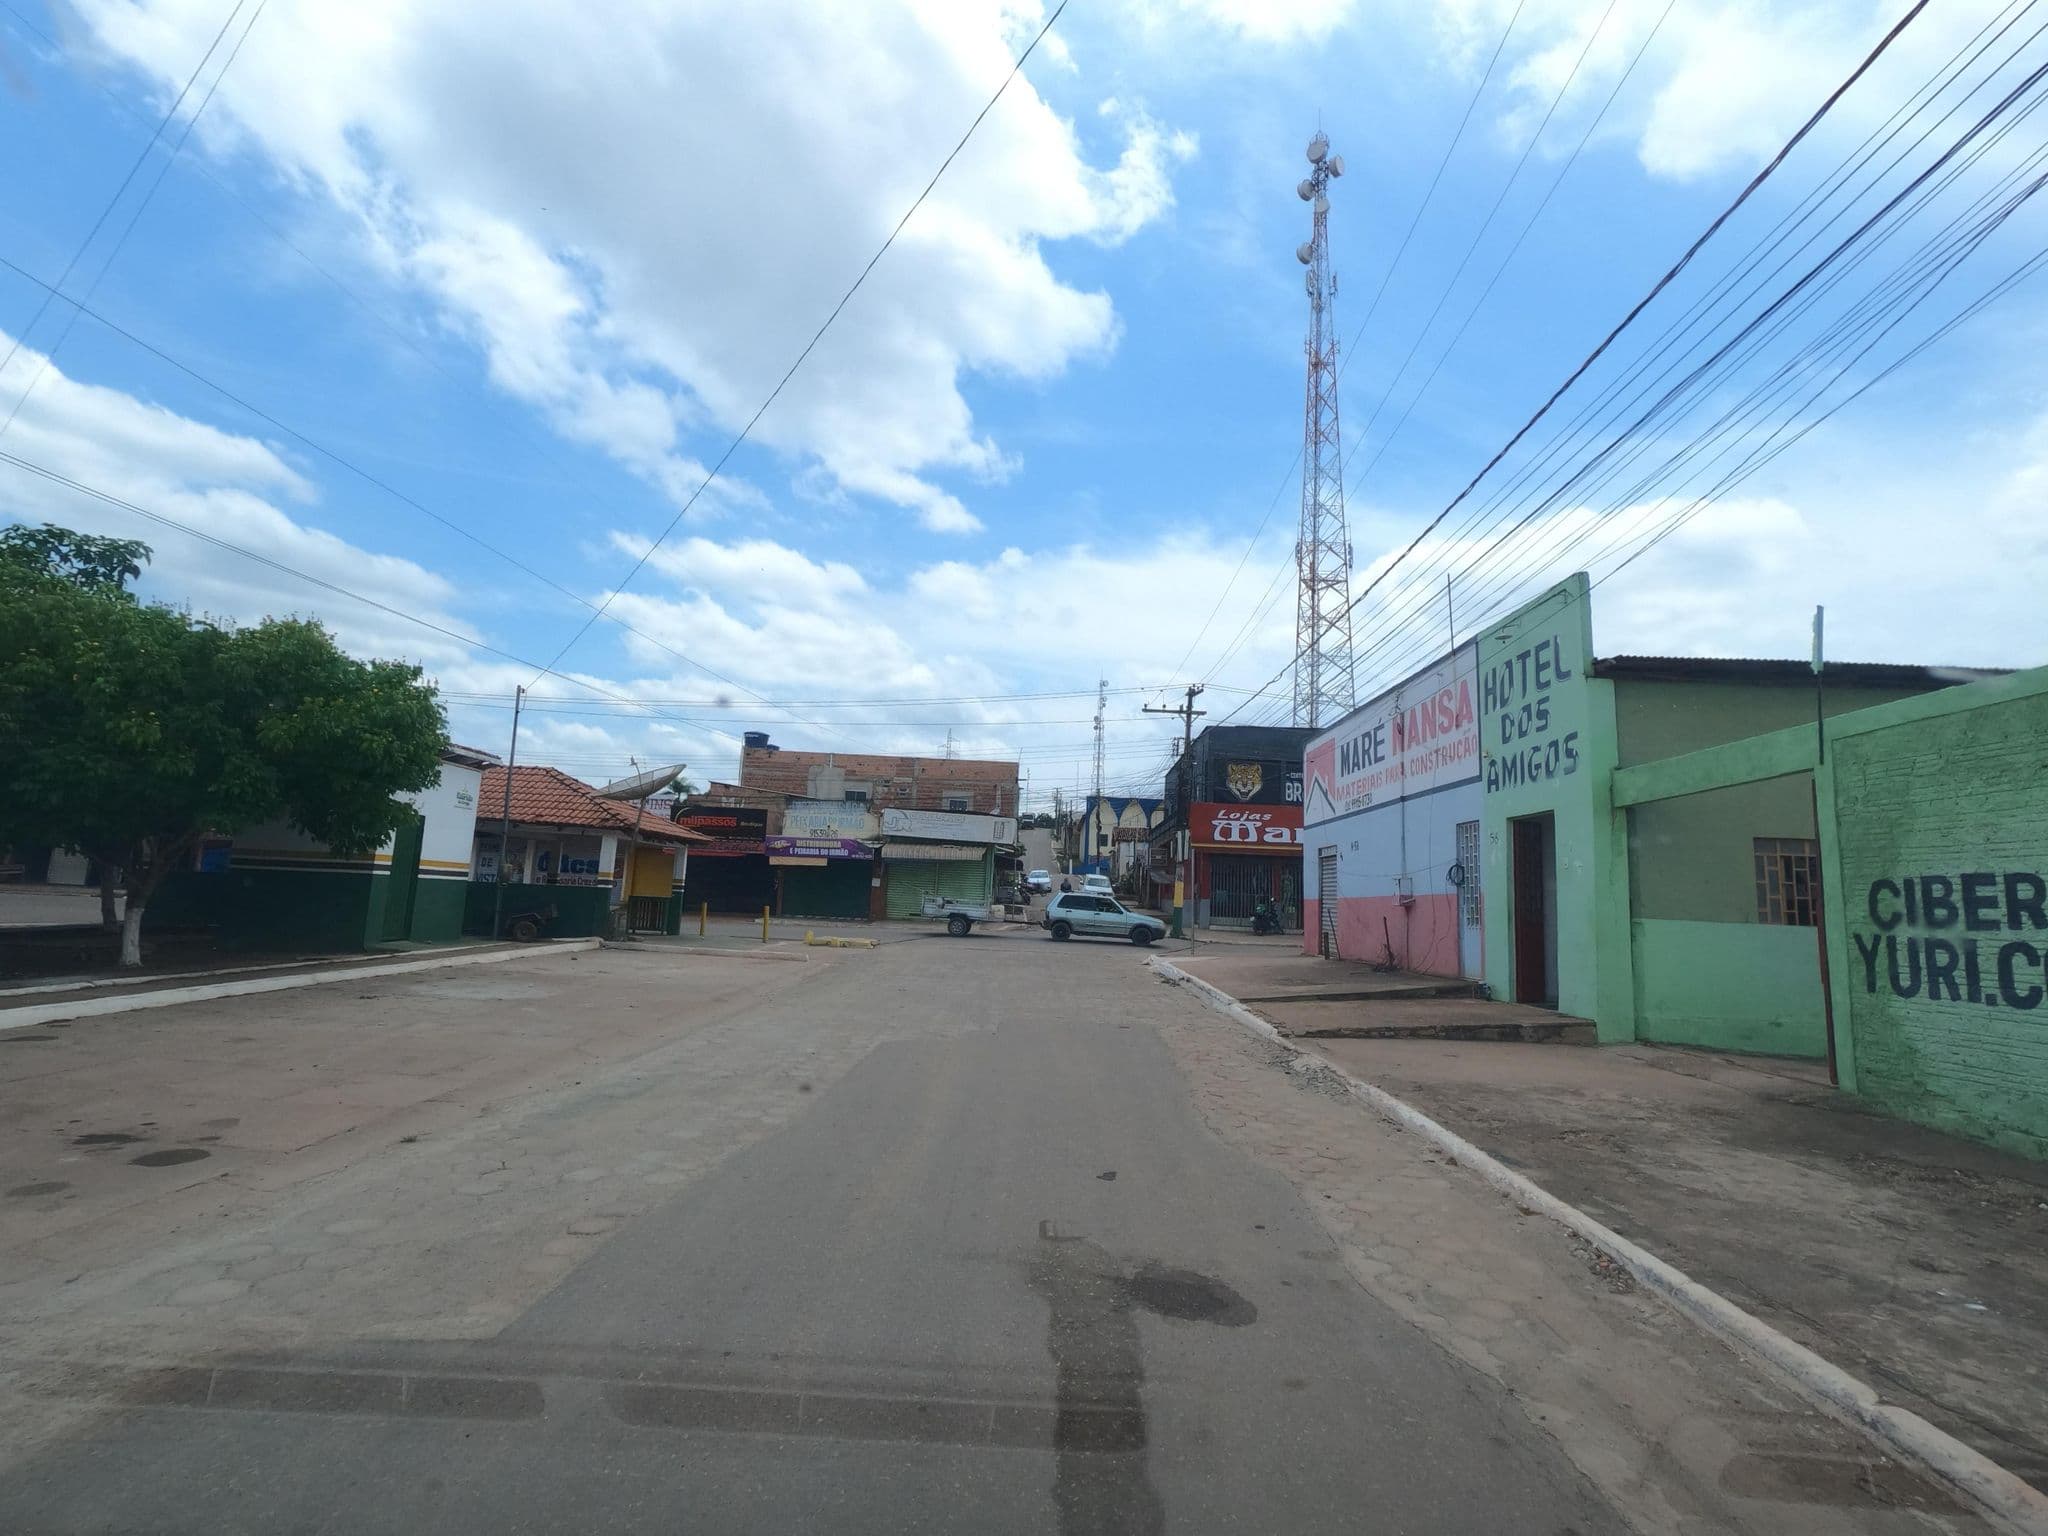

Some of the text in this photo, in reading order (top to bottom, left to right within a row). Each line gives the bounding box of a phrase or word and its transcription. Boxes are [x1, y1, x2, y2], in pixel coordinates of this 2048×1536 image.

[1484, 635, 1572, 715] HOTEL
[1341, 717, 1386, 778] MARÉ
[1501, 696, 1551, 744] DOS
[1285, 782, 1304, 802] BR
[1487, 731, 1580, 794] AMIGOS
[1218, 809, 1272, 822] Lojas
[1869, 872, 2048, 931] CIBER
[1853, 933, 2048, 1010] YURI.C
